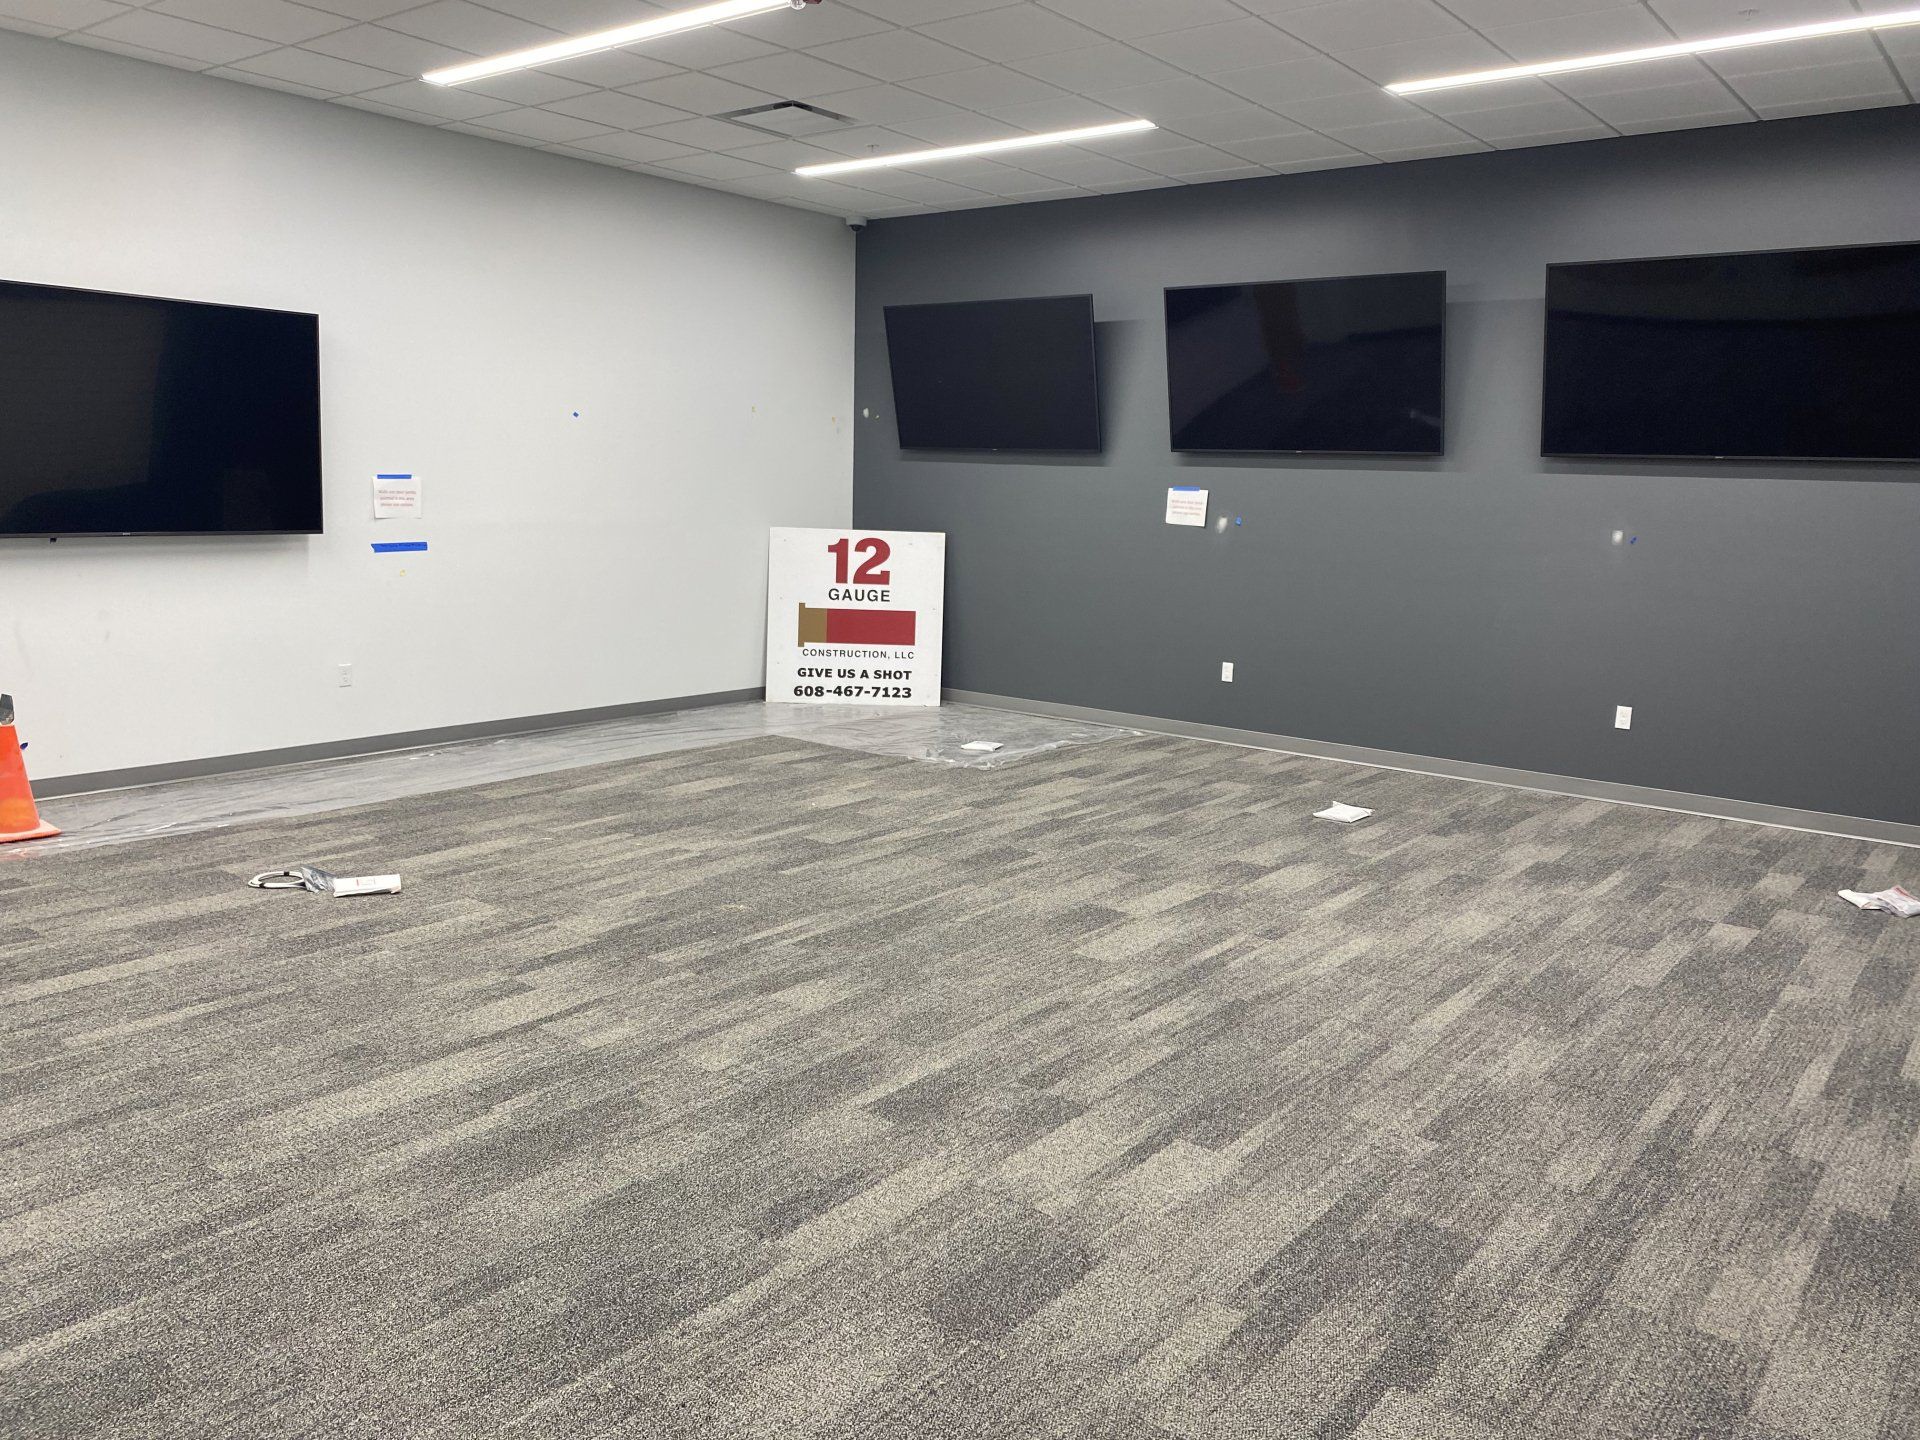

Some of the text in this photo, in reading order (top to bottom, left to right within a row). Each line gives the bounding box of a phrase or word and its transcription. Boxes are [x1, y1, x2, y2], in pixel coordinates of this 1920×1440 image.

[827, 537, 891, 586] 12
[828, 588, 891, 603] GAUGE
[802, 648, 915, 660] CONSTRUCTION, LLC
[797, 667, 913, 681] GIVE US A SHOT
[793, 685, 913, 699] 608-467-7123
